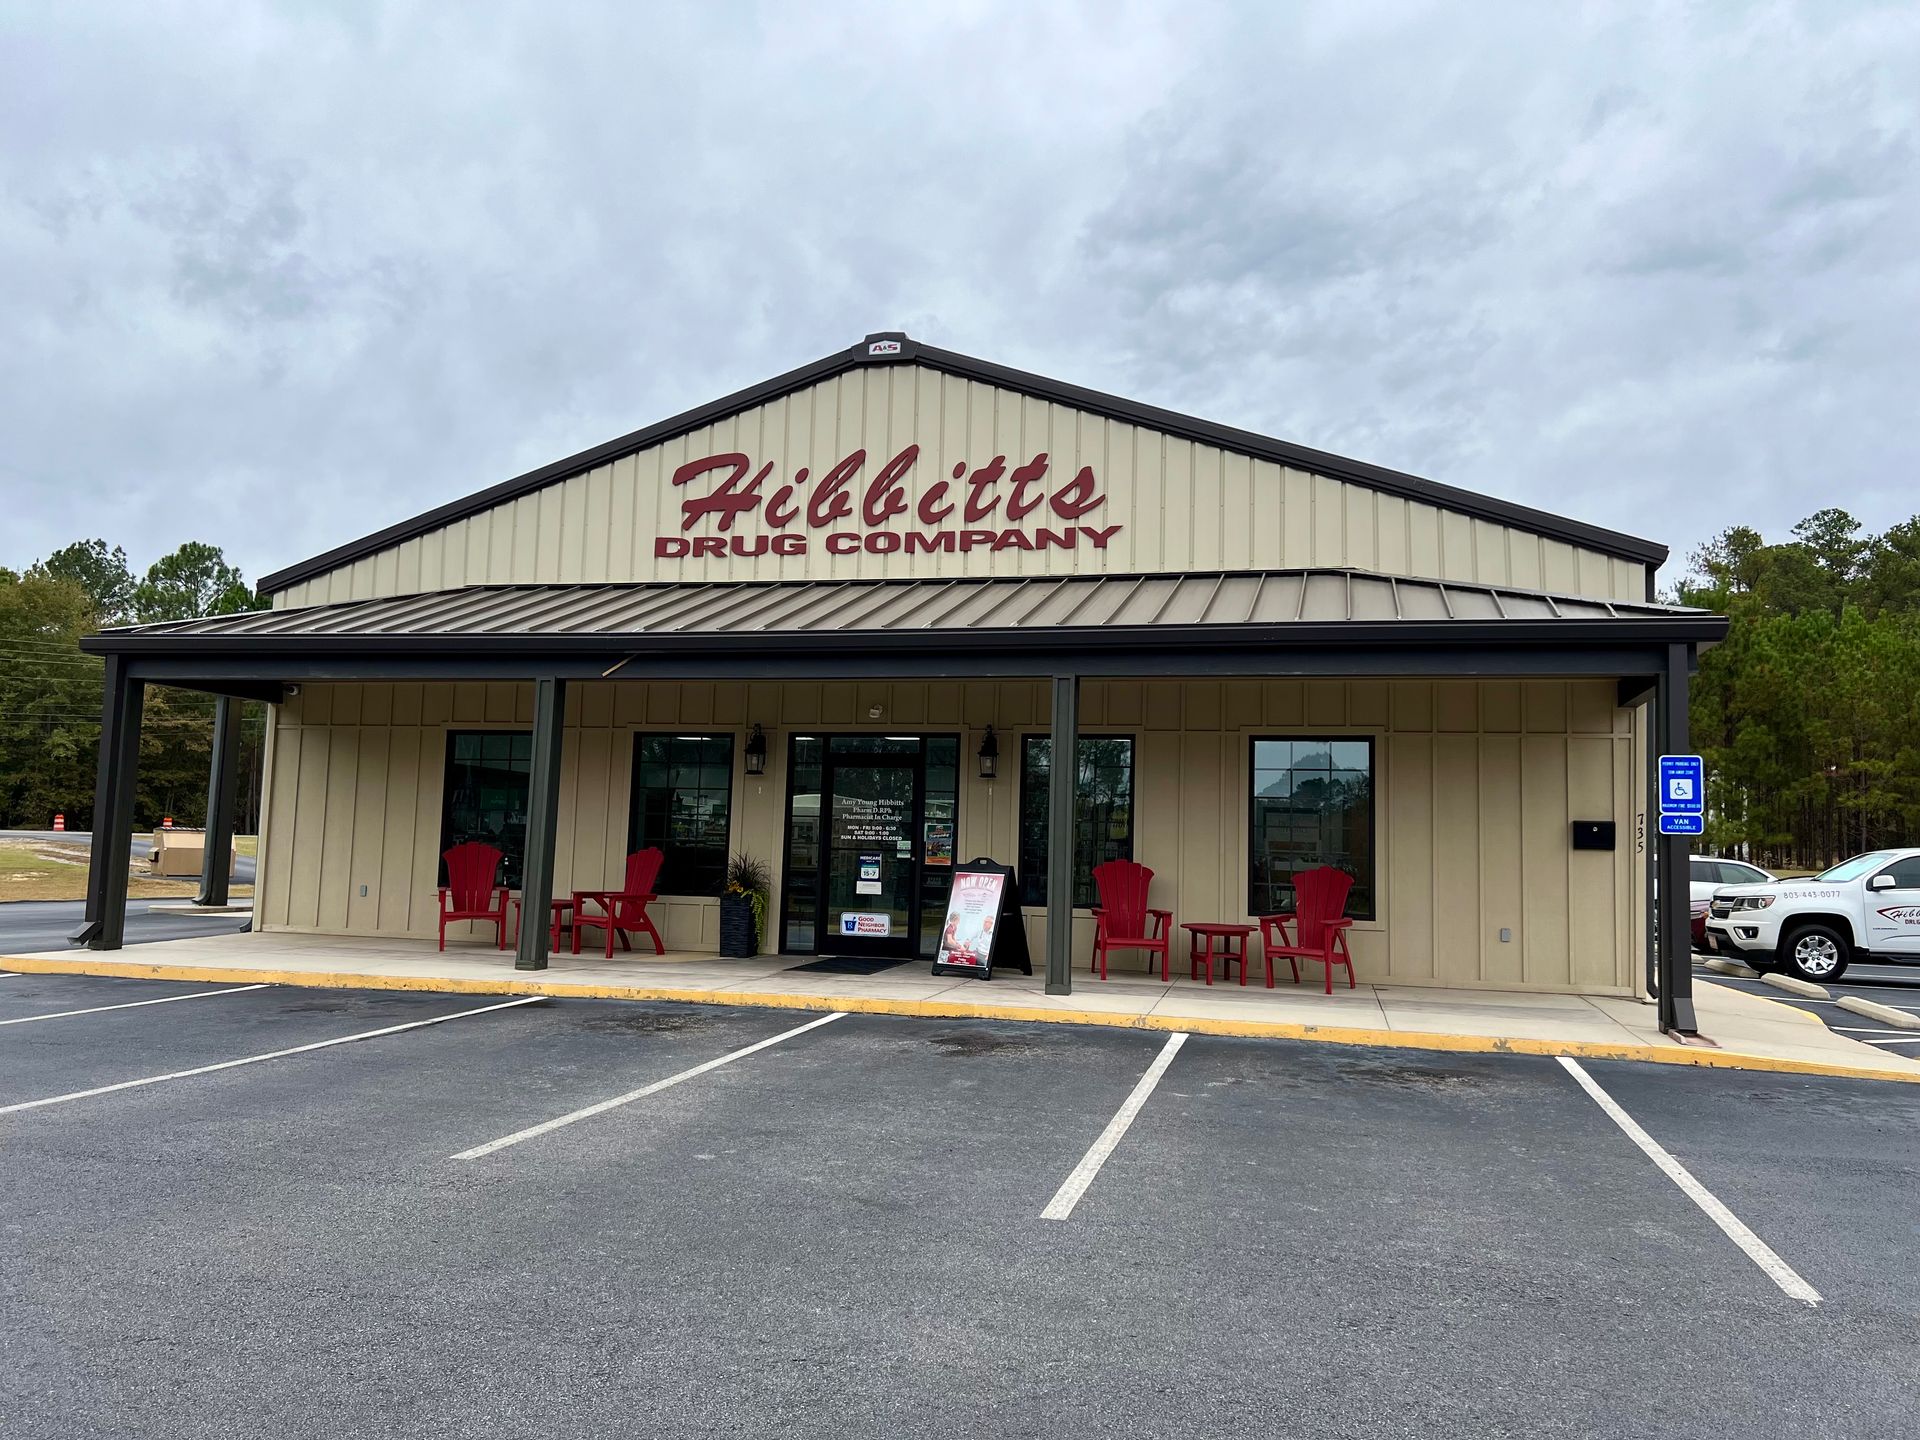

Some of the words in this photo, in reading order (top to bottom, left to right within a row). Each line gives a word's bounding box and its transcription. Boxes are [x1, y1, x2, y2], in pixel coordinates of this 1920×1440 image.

[672, 444, 1106, 532] Hibbitts
[654, 533, 807, 558] DRUG
[825, 525, 1123, 555] COMPANY
[858, 799, 877, 807] Young
[961, 876, 977, 889] NOW
[979, 876, 997, 891] OPEN
